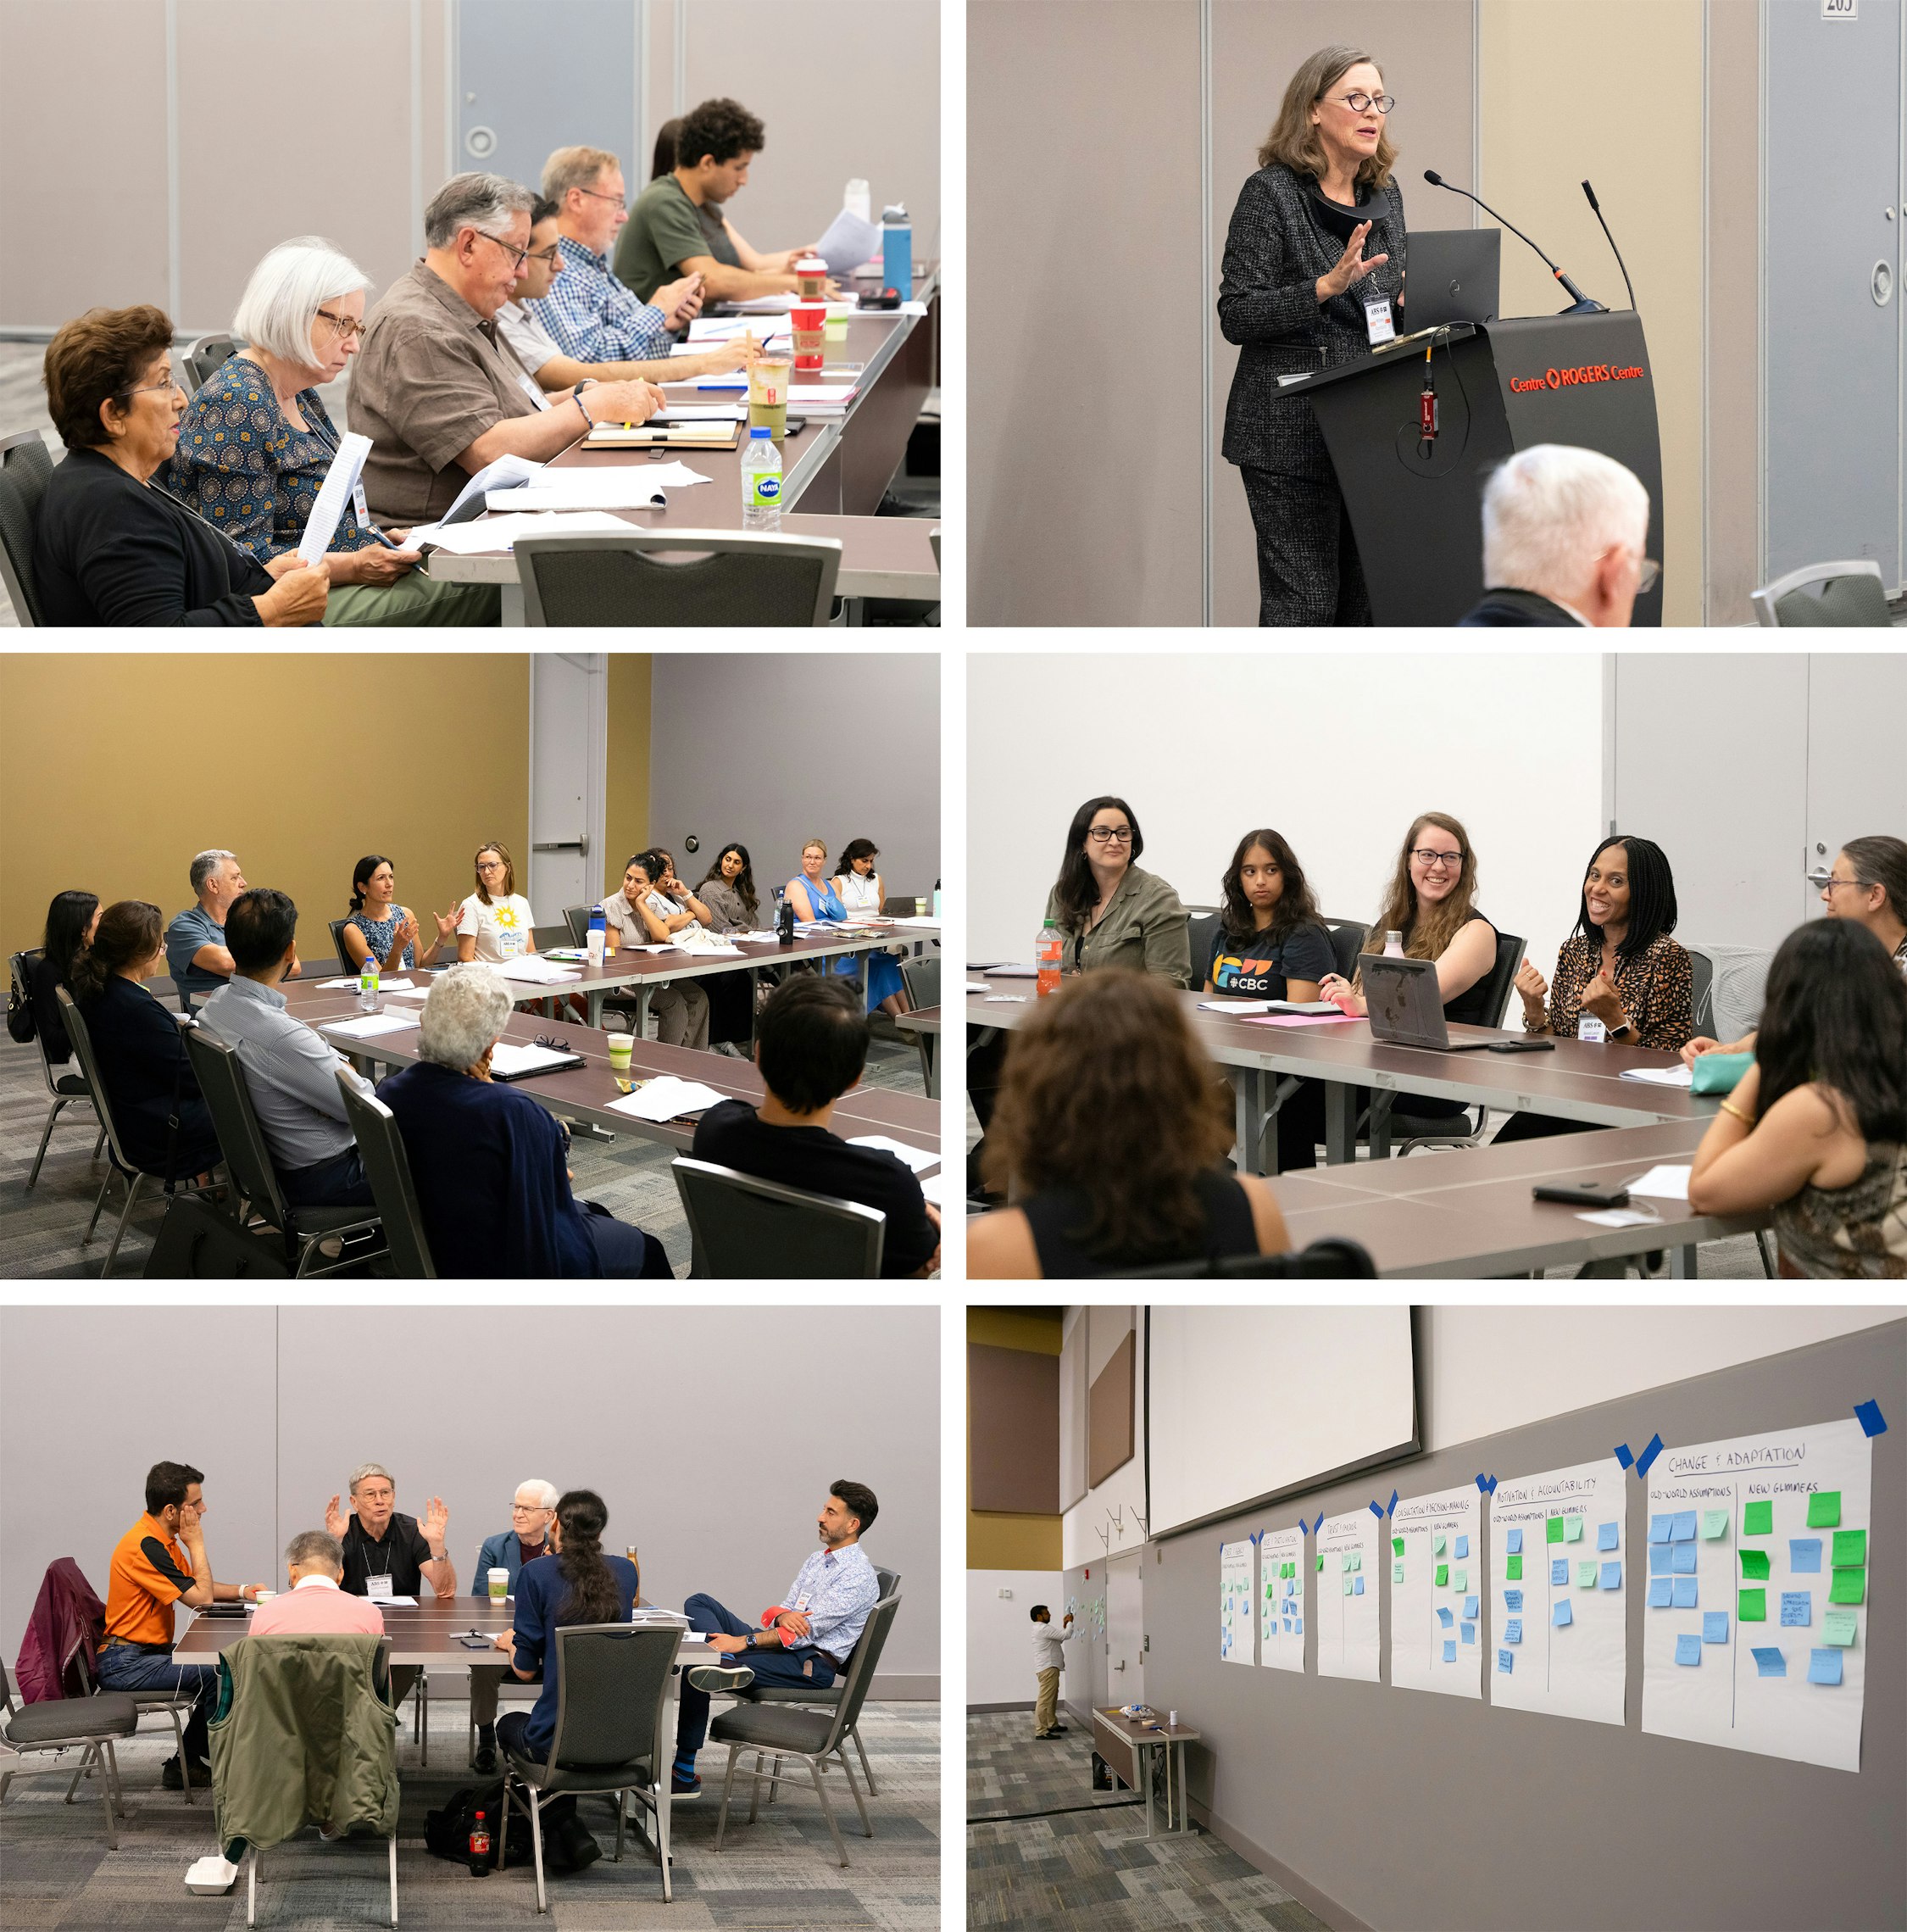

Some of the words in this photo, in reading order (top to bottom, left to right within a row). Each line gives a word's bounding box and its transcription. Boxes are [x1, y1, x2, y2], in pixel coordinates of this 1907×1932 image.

[1510, 377, 1546, 393] Centre
[1561, 364, 1610, 386] ROGERS
[1610, 365, 1644, 381] Centre
[759, 483, 779, 493] NAYA
[1238, 977, 1269, 991] CBC
[1668, 1455, 1708, 1473] CHANGE
[1726, 1443, 1806, 1467] ADAPTATION
[1497, 1489, 1528, 1503] MOTIVATION
[1538, 1478, 1597, 1496] ACCOUNTABILITY
[1650, 1489, 1687, 1500] OLD-WORLD
[1688, 1486, 1732, 1498] ASSUMPTIONS
[1749, 1484, 1771, 1495] NEW
[1773, 1483, 1819, 1494] GLIMMERS
[1550, 1507, 1560, 1517] NEW
